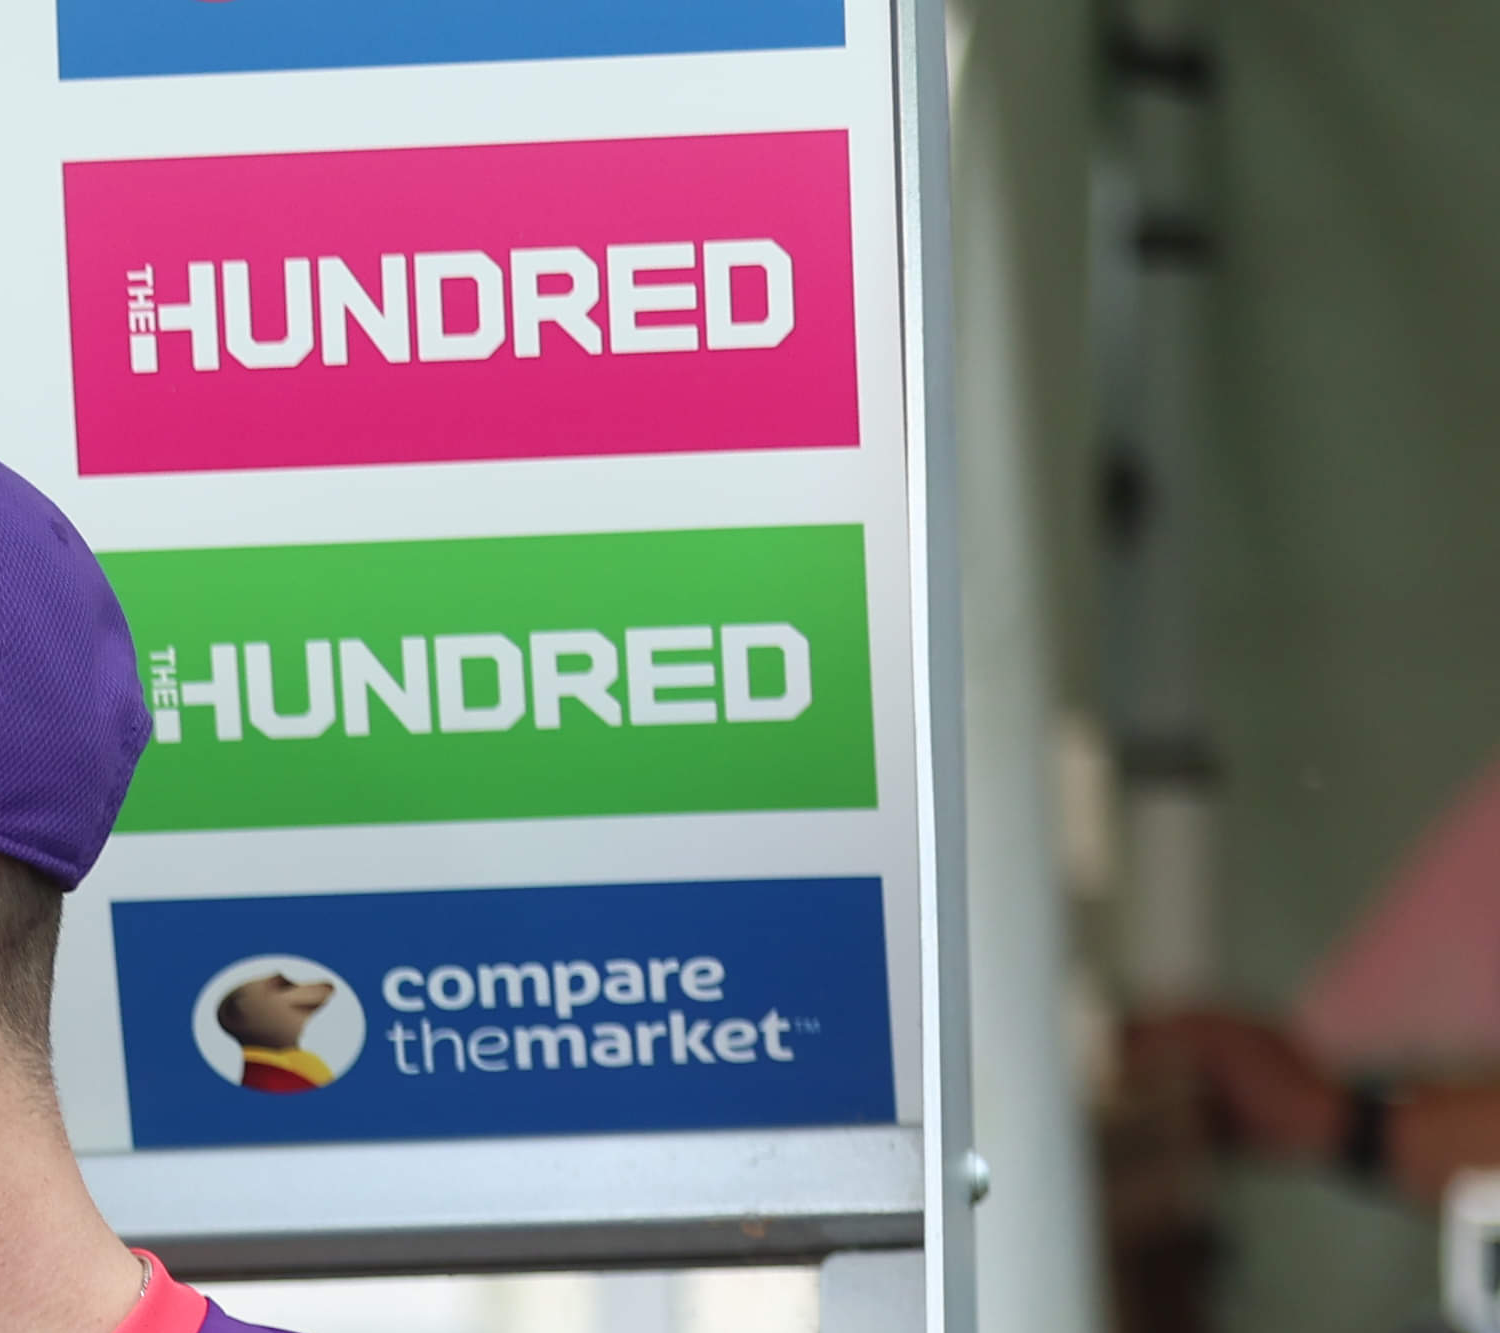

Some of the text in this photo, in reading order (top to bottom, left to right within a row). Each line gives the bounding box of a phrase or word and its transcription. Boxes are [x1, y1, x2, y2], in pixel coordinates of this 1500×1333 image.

[129, 239, 795, 373] HUNDRED
[154, 622, 813, 743] HUNDRED
[382, 956, 725, 1018] compare
